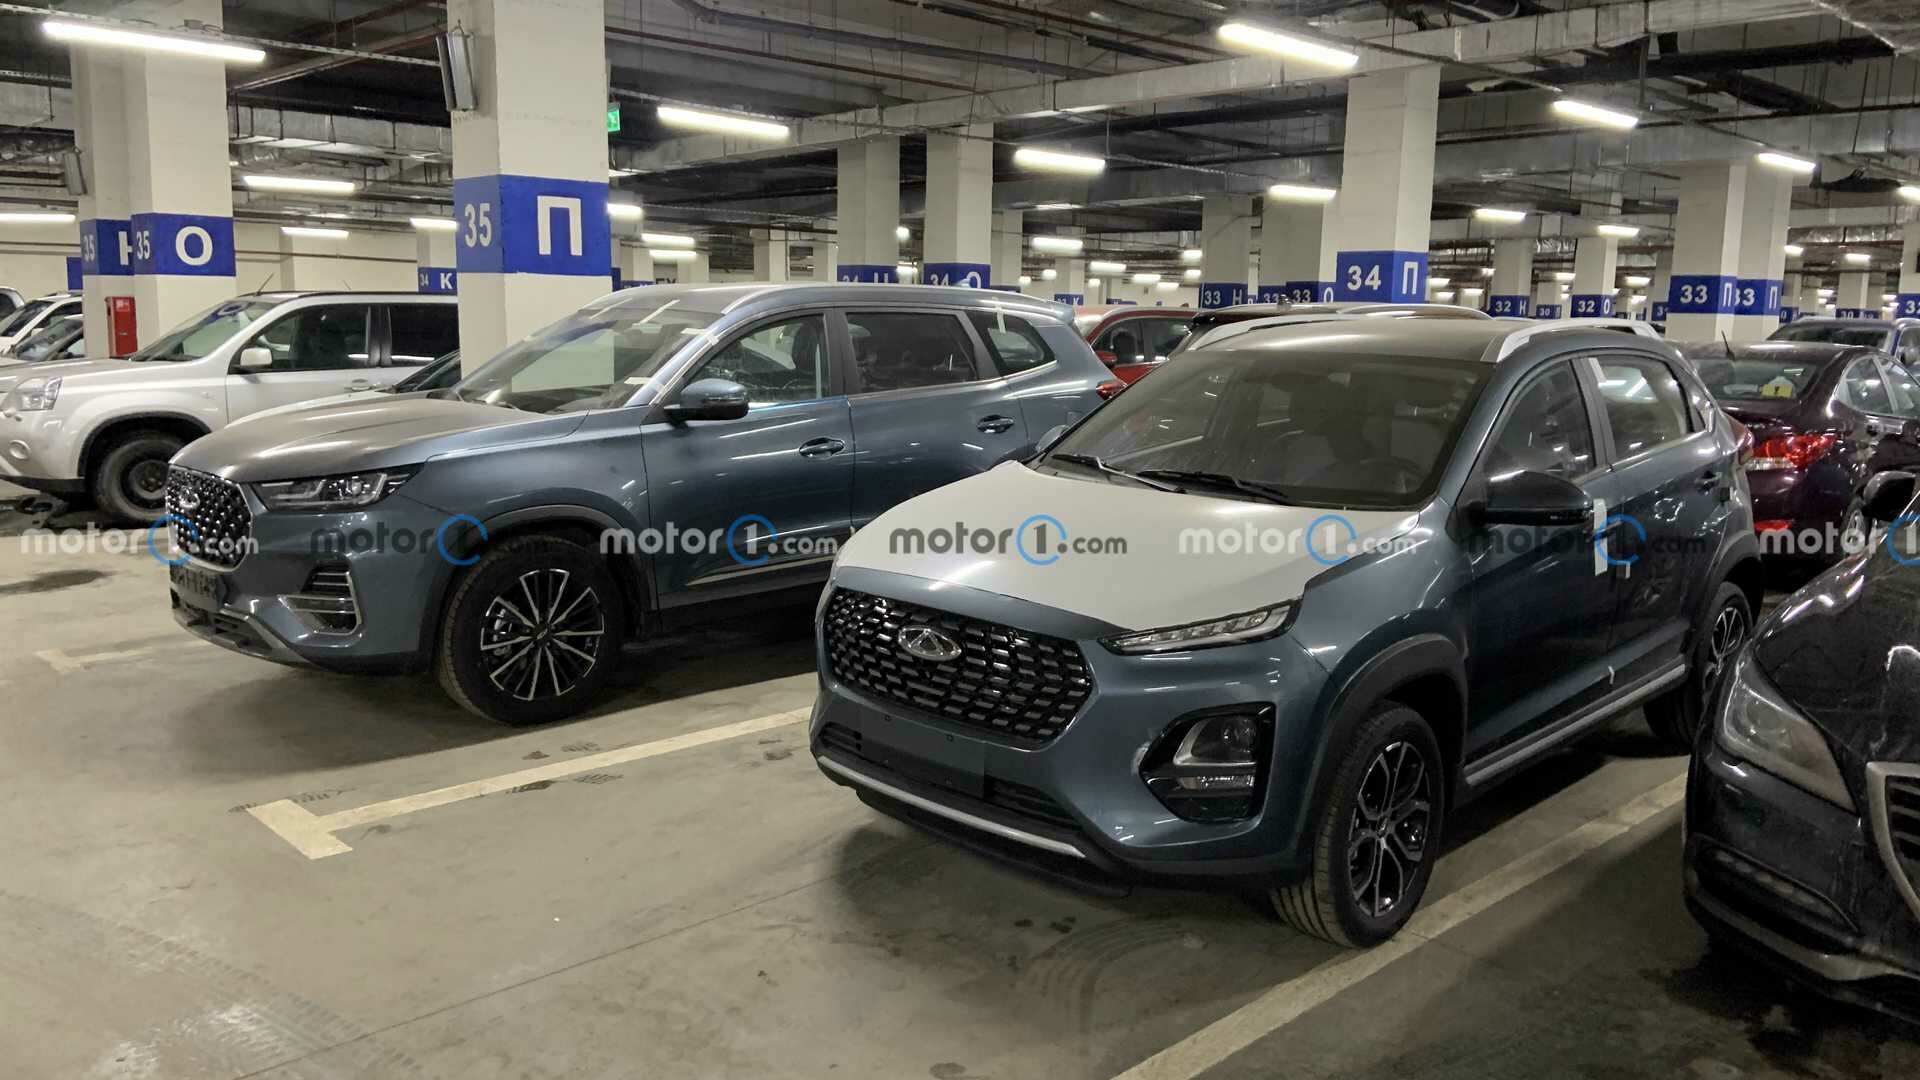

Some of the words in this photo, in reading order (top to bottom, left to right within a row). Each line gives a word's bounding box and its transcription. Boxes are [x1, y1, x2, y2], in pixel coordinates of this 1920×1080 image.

[464, 202, 493, 248] 35
[536, 195, 583, 257] П
[83, 234, 96, 262] 35
[136, 231, 151, 260] 35
[1346, 264, 1382, 291] 34
[1402, 261, 1419, 295] П
[1204, 290, 1221, 305] 33
[1291, 289, 1311, 304] 33
[1679, 284, 1708, 304] 33
[1495, 300, 1512, 313] 32
[1577, 300, 1596, 313] 32
